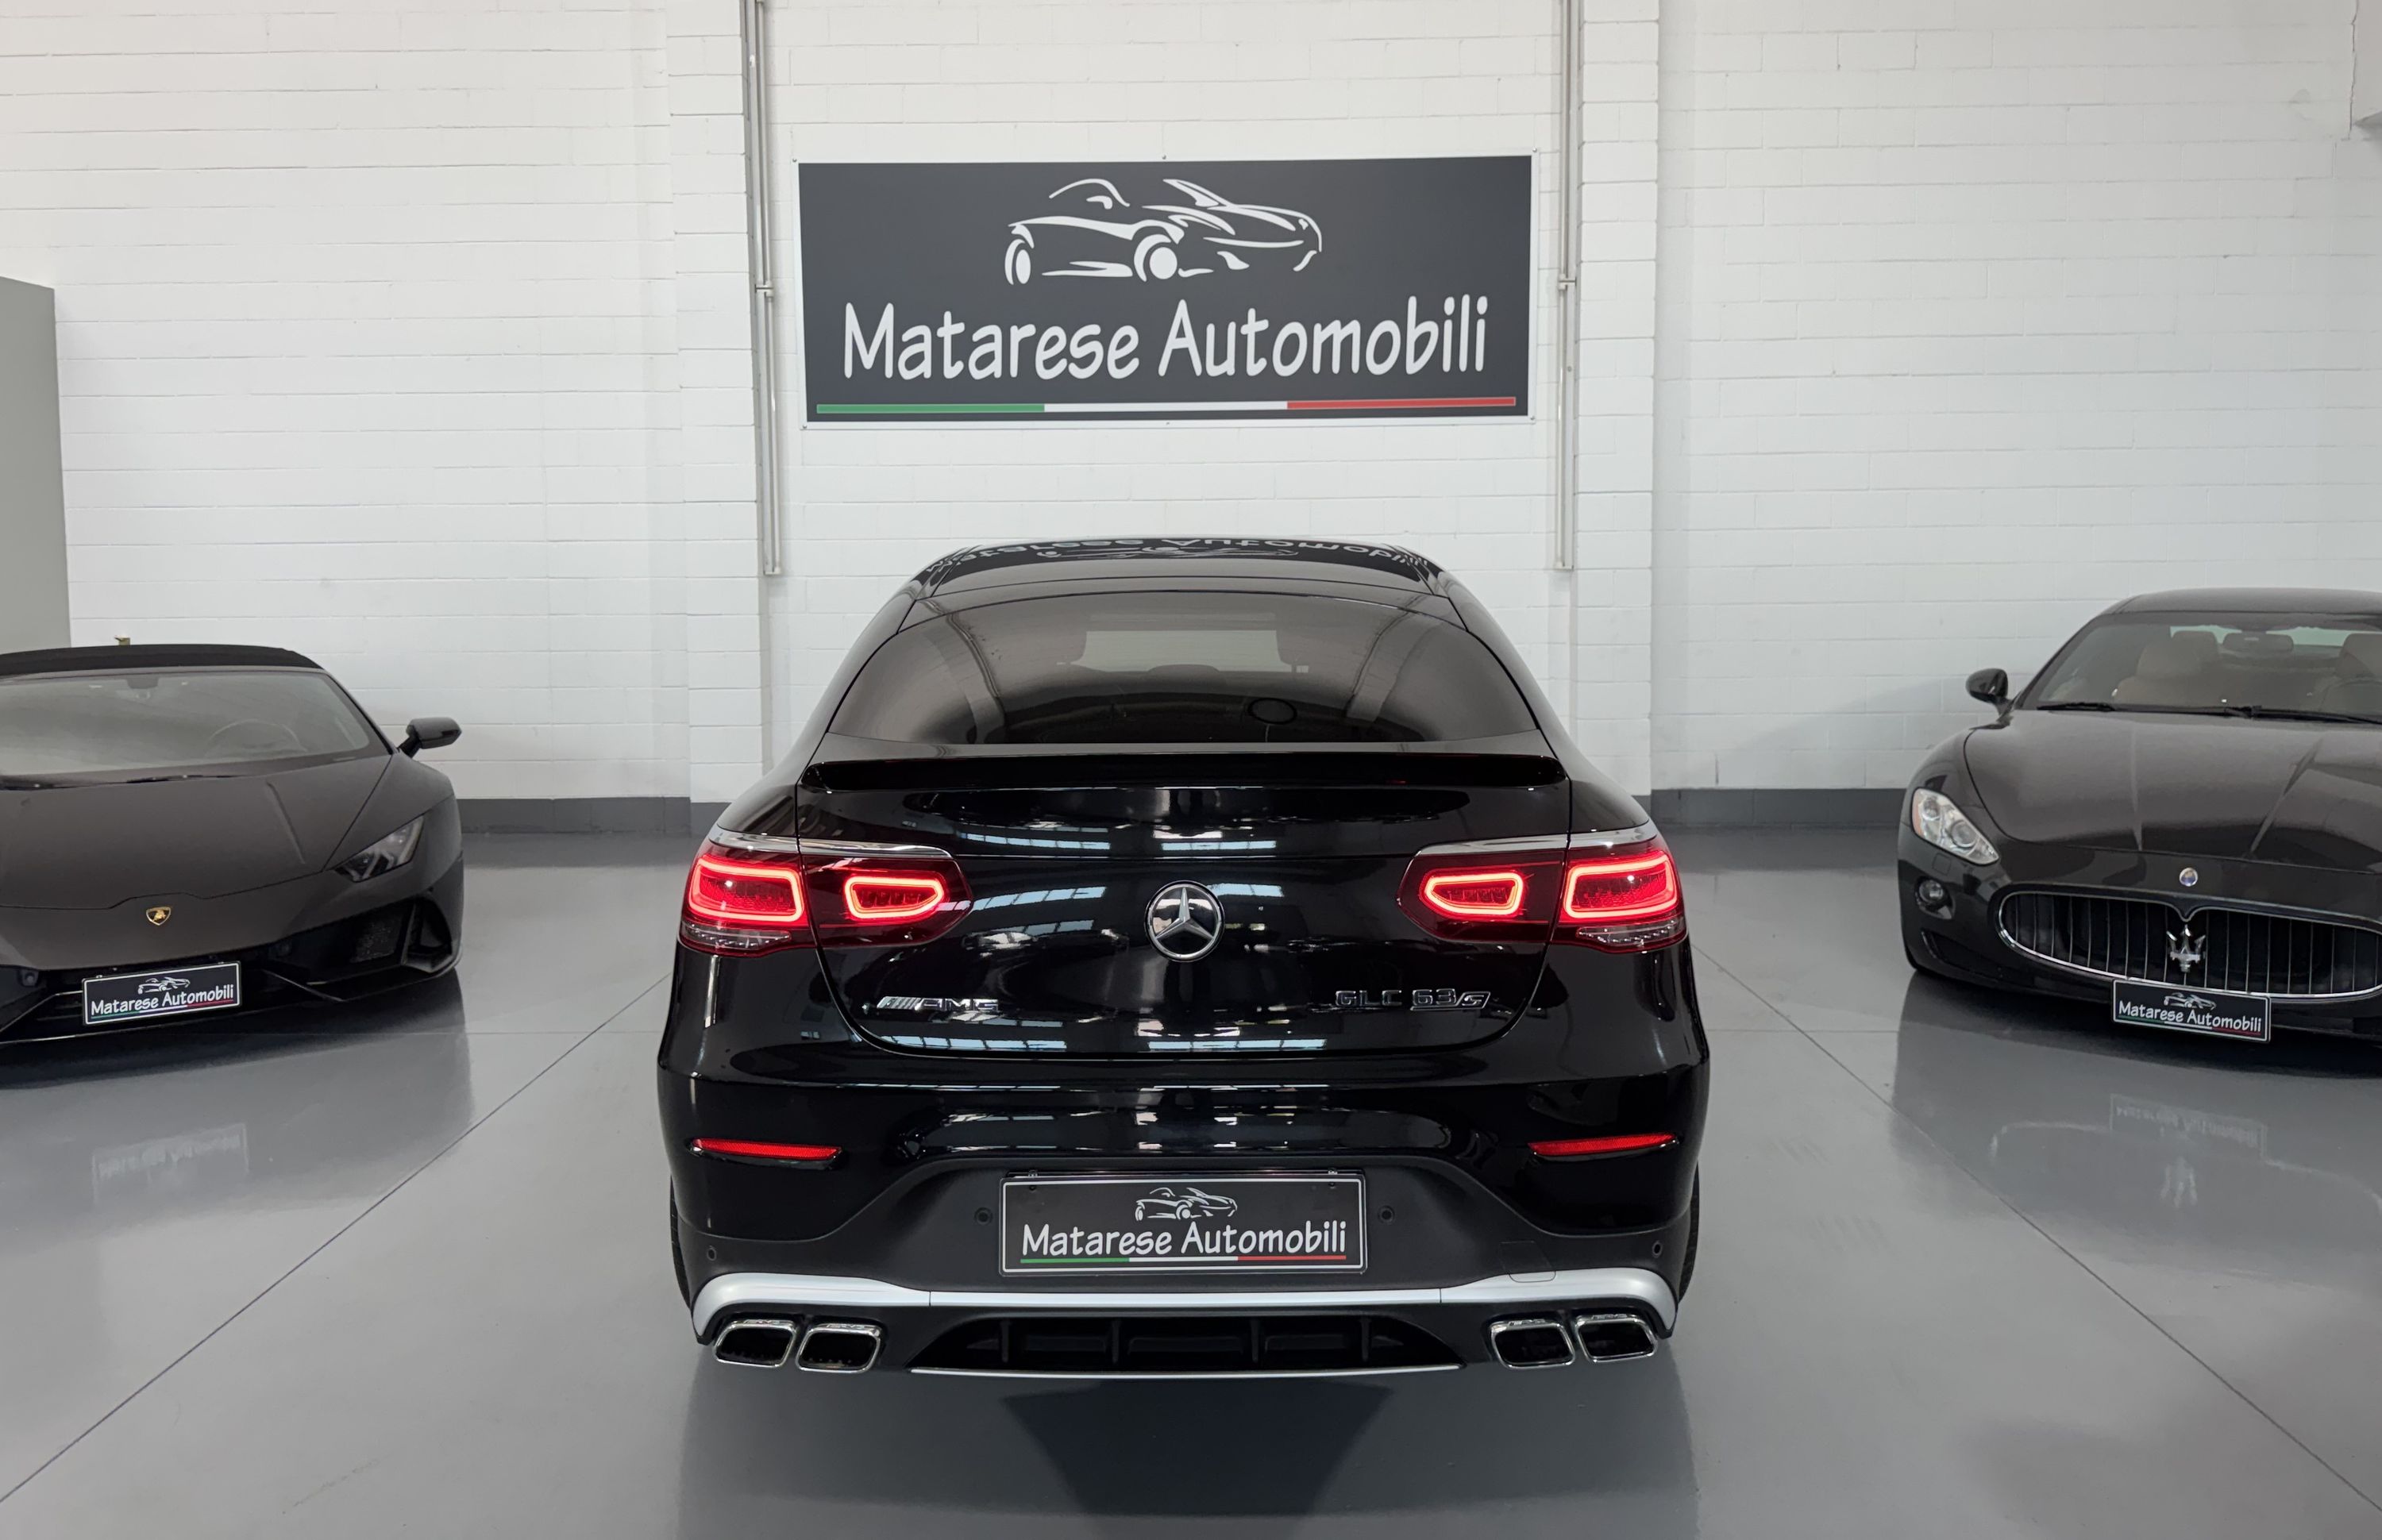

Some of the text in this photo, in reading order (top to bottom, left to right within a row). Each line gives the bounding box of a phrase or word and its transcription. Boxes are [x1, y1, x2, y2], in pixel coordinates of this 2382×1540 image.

[845, 295, 1487, 380] Matarese Automobili
[91, 984, 234, 1015] Matarese Automobili
[1335, 990, 1403, 1007] GLC
[2118, 1000, 2261, 1032] Matarese Automobili
[1022, 1220, 1347, 1257] Matarese Automobili
